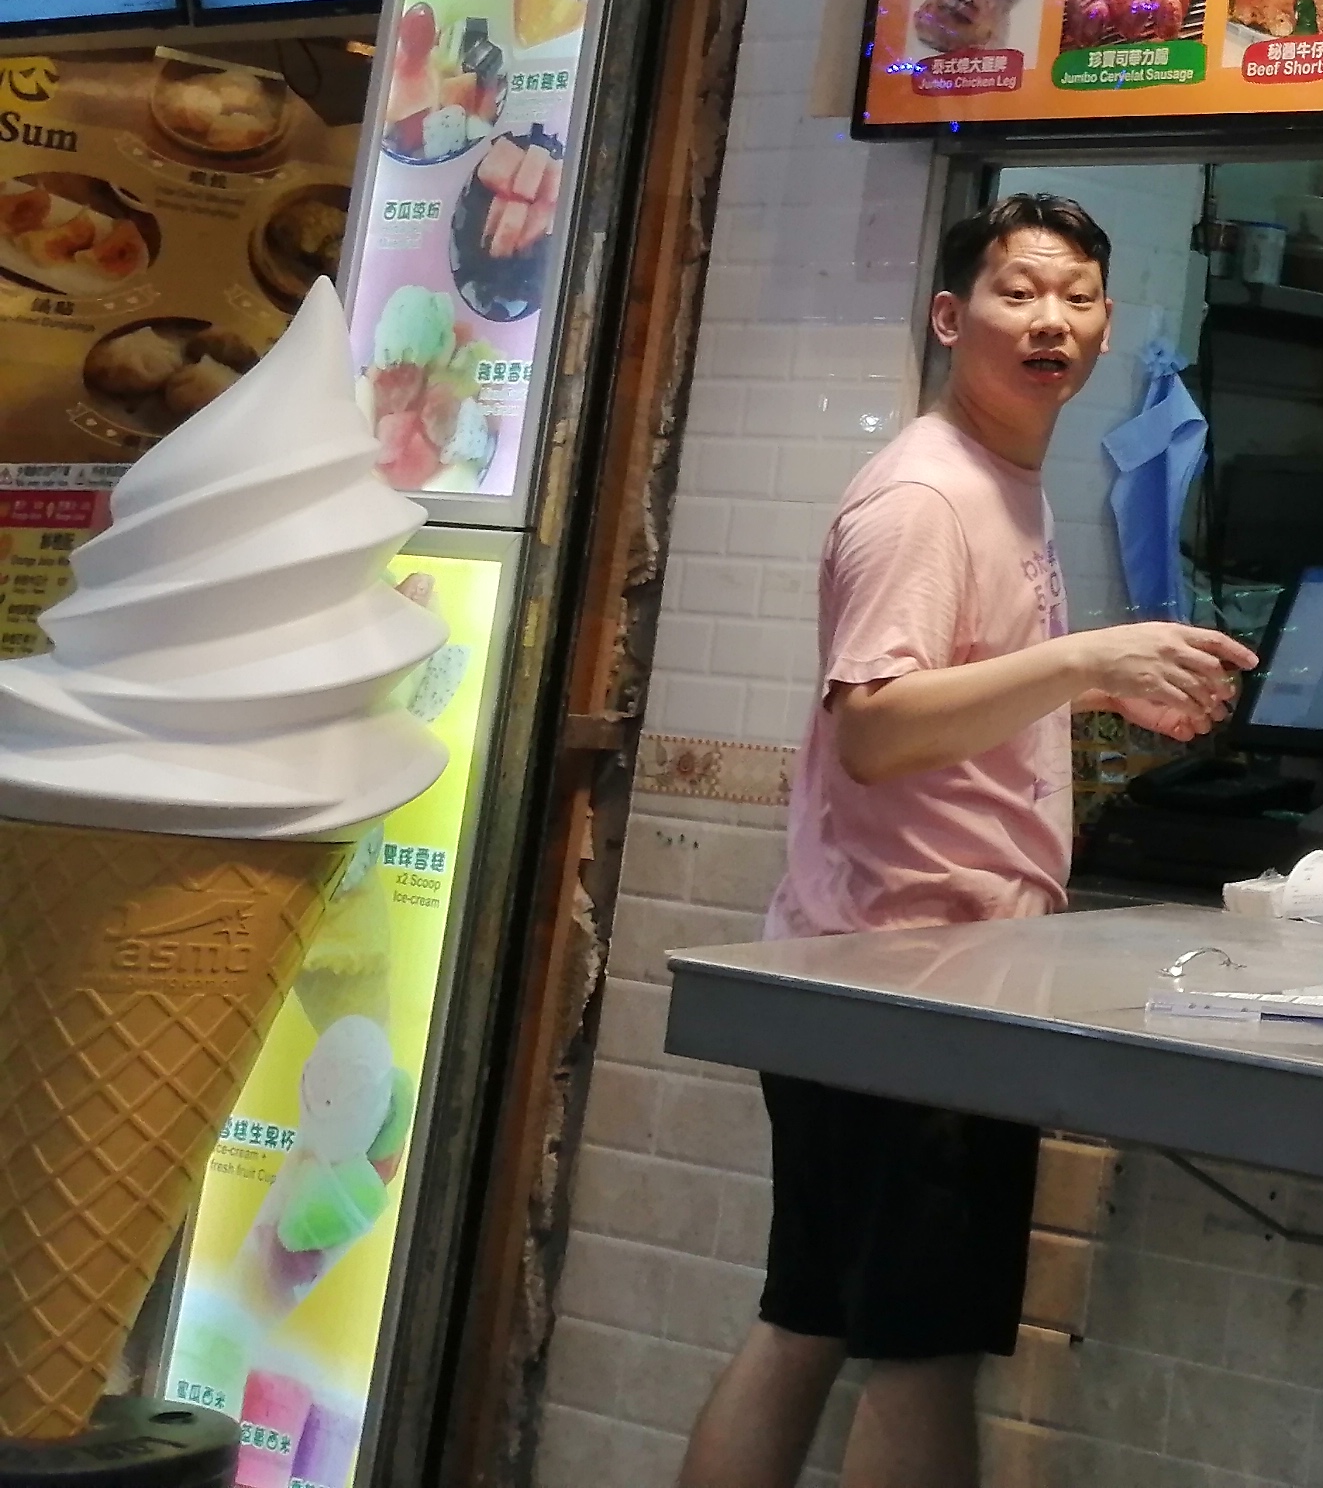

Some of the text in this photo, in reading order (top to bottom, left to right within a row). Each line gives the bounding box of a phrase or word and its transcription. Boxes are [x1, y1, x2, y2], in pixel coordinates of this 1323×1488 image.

[1061, 71, 1098, 85] Jumbo
[1146, 67, 1194, 83] Sausage
[1247, 62, 1282, 77] Beef
[1283, 60, 1323, 76] Short
[954, 75, 994, 89] Chicken
[996, 74, 1017, 90] Leg
[0, 111, 78, 152] Sum
[411, 874, 441, 891] Scoop
[393, 890, 440, 909] Ice-cream
